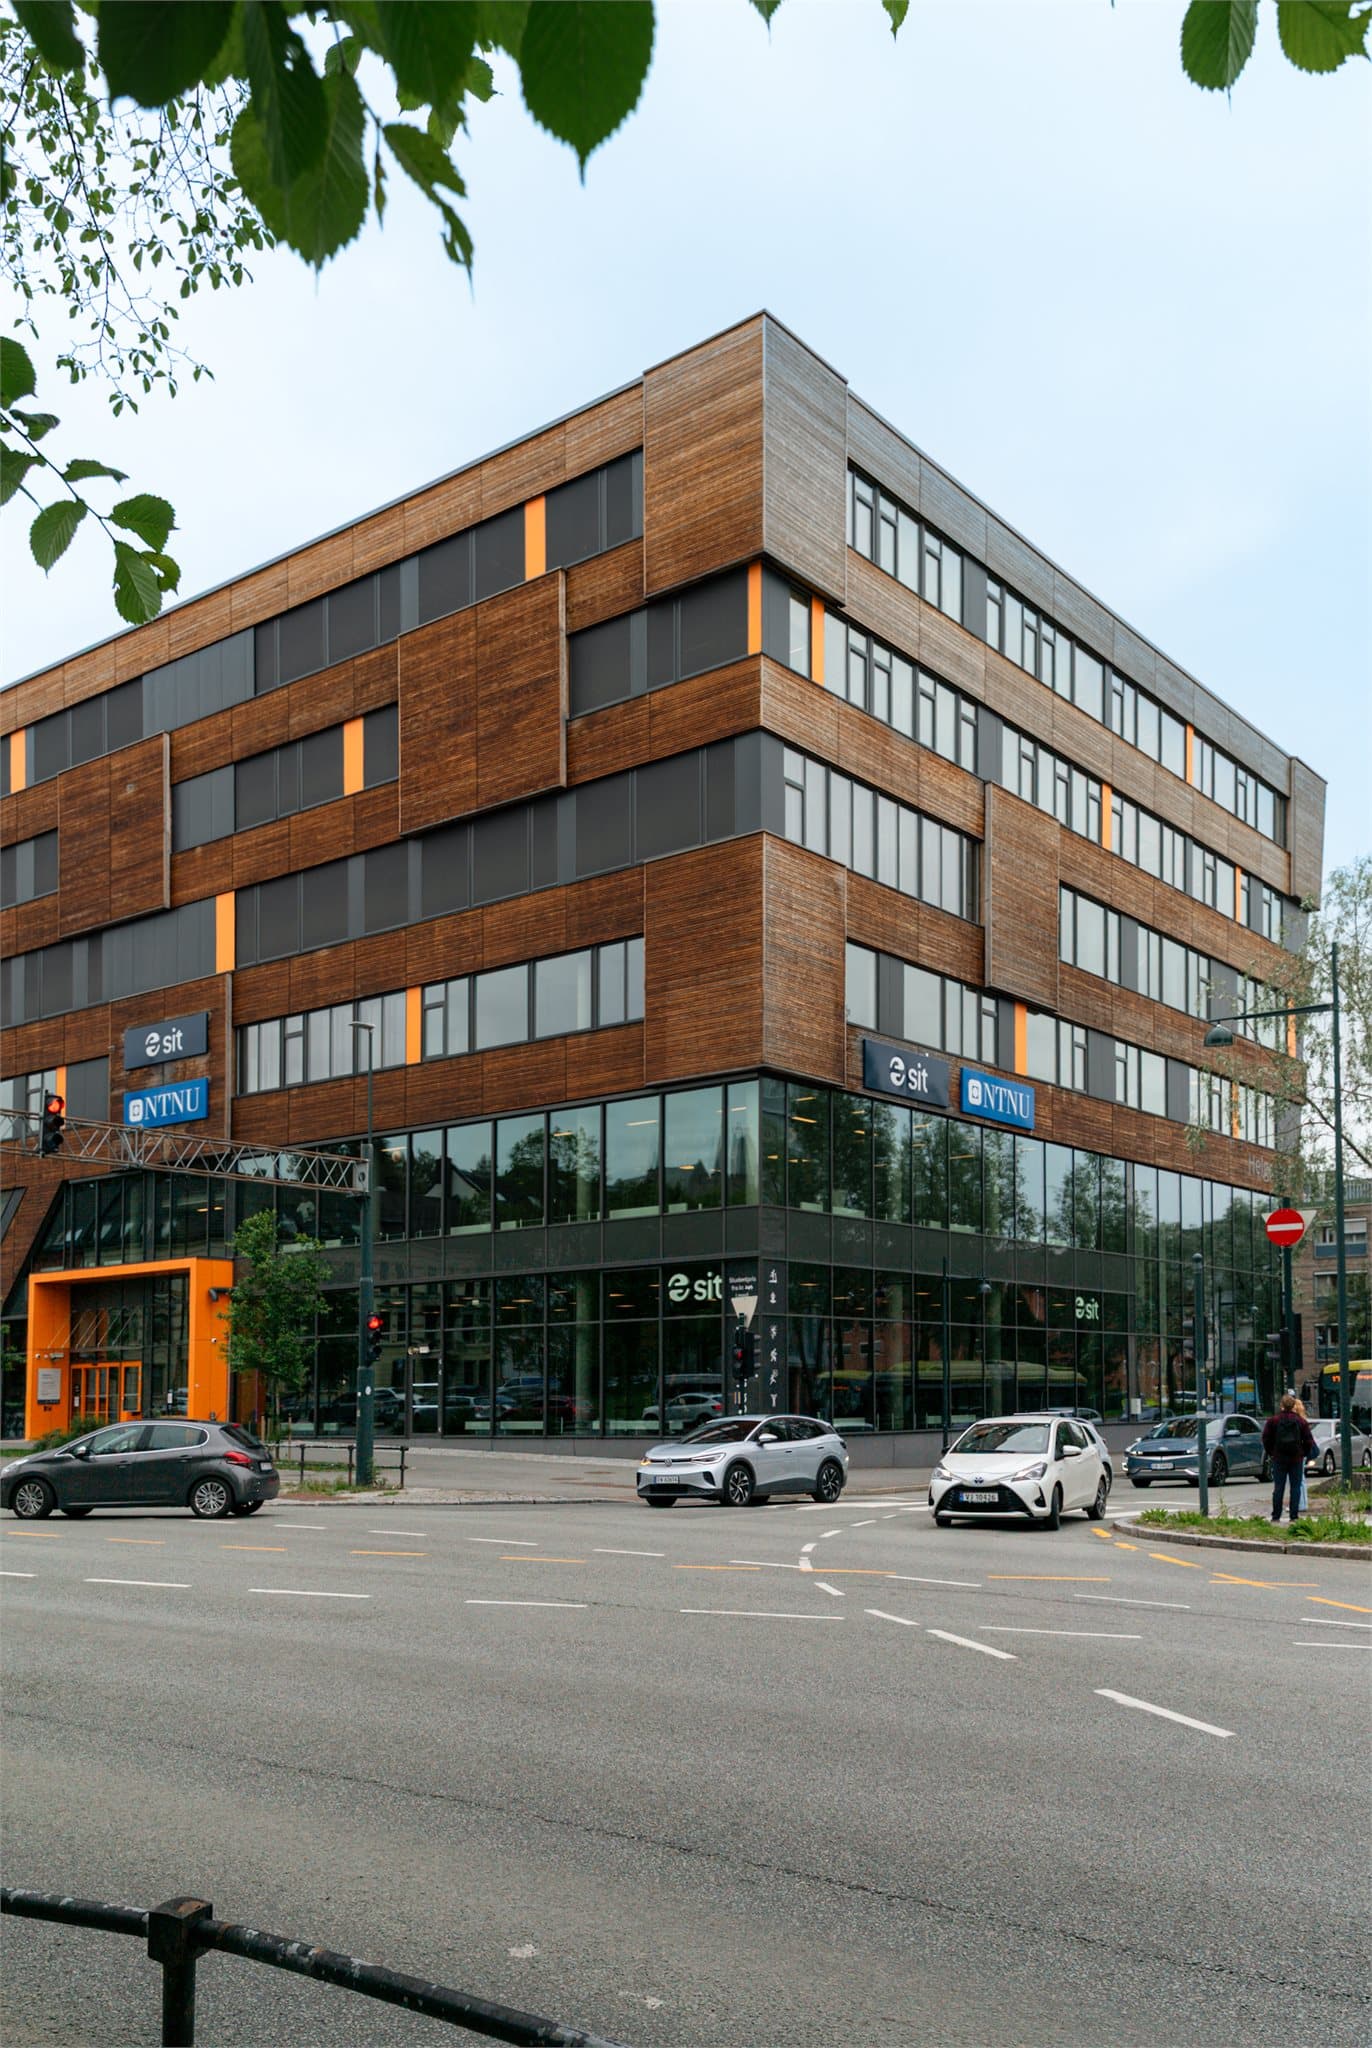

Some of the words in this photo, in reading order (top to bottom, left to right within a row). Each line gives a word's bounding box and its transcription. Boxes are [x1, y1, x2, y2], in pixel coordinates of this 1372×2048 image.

[163, 1027, 183, 1054] sit
[908, 1063, 928, 1093] sit
[144, 1087, 200, 1120] NTNU
[983, 1082, 1030, 1119] NTNU
